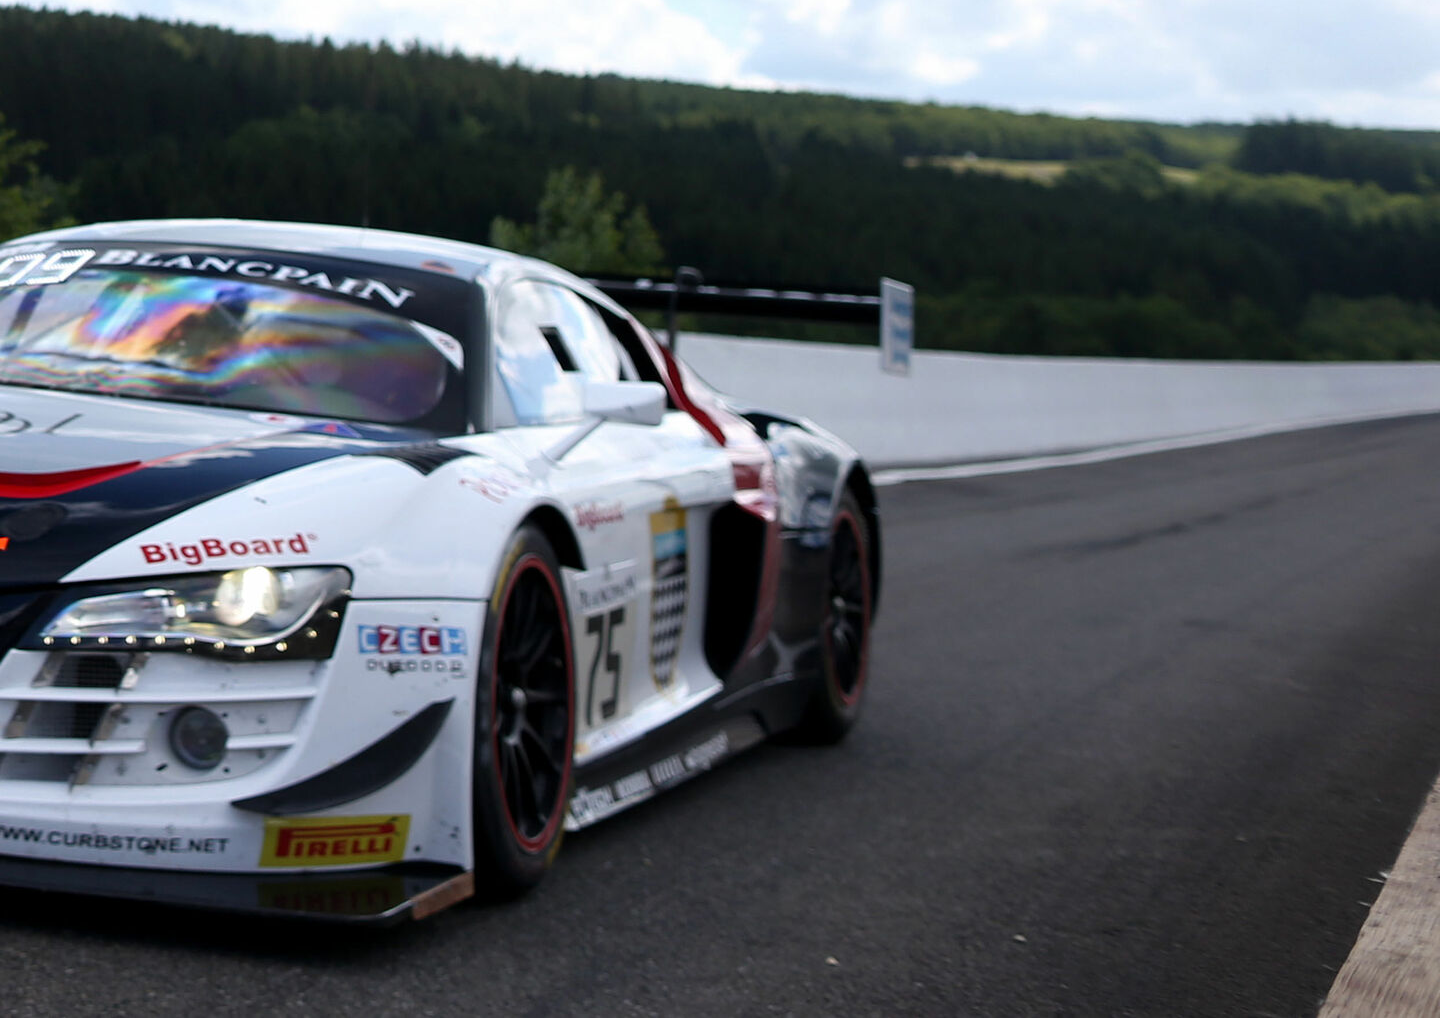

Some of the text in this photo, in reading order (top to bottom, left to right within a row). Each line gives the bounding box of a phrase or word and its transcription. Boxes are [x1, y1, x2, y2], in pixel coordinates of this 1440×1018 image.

[93, 248, 417, 310] BLANCPAIN
[139, 533, 310, 566] BigBoard
[359, 625, 467, 655] CZECH
[586, 604, 626, 727] 75
[275, 821, 397, 859] PIRELLI
